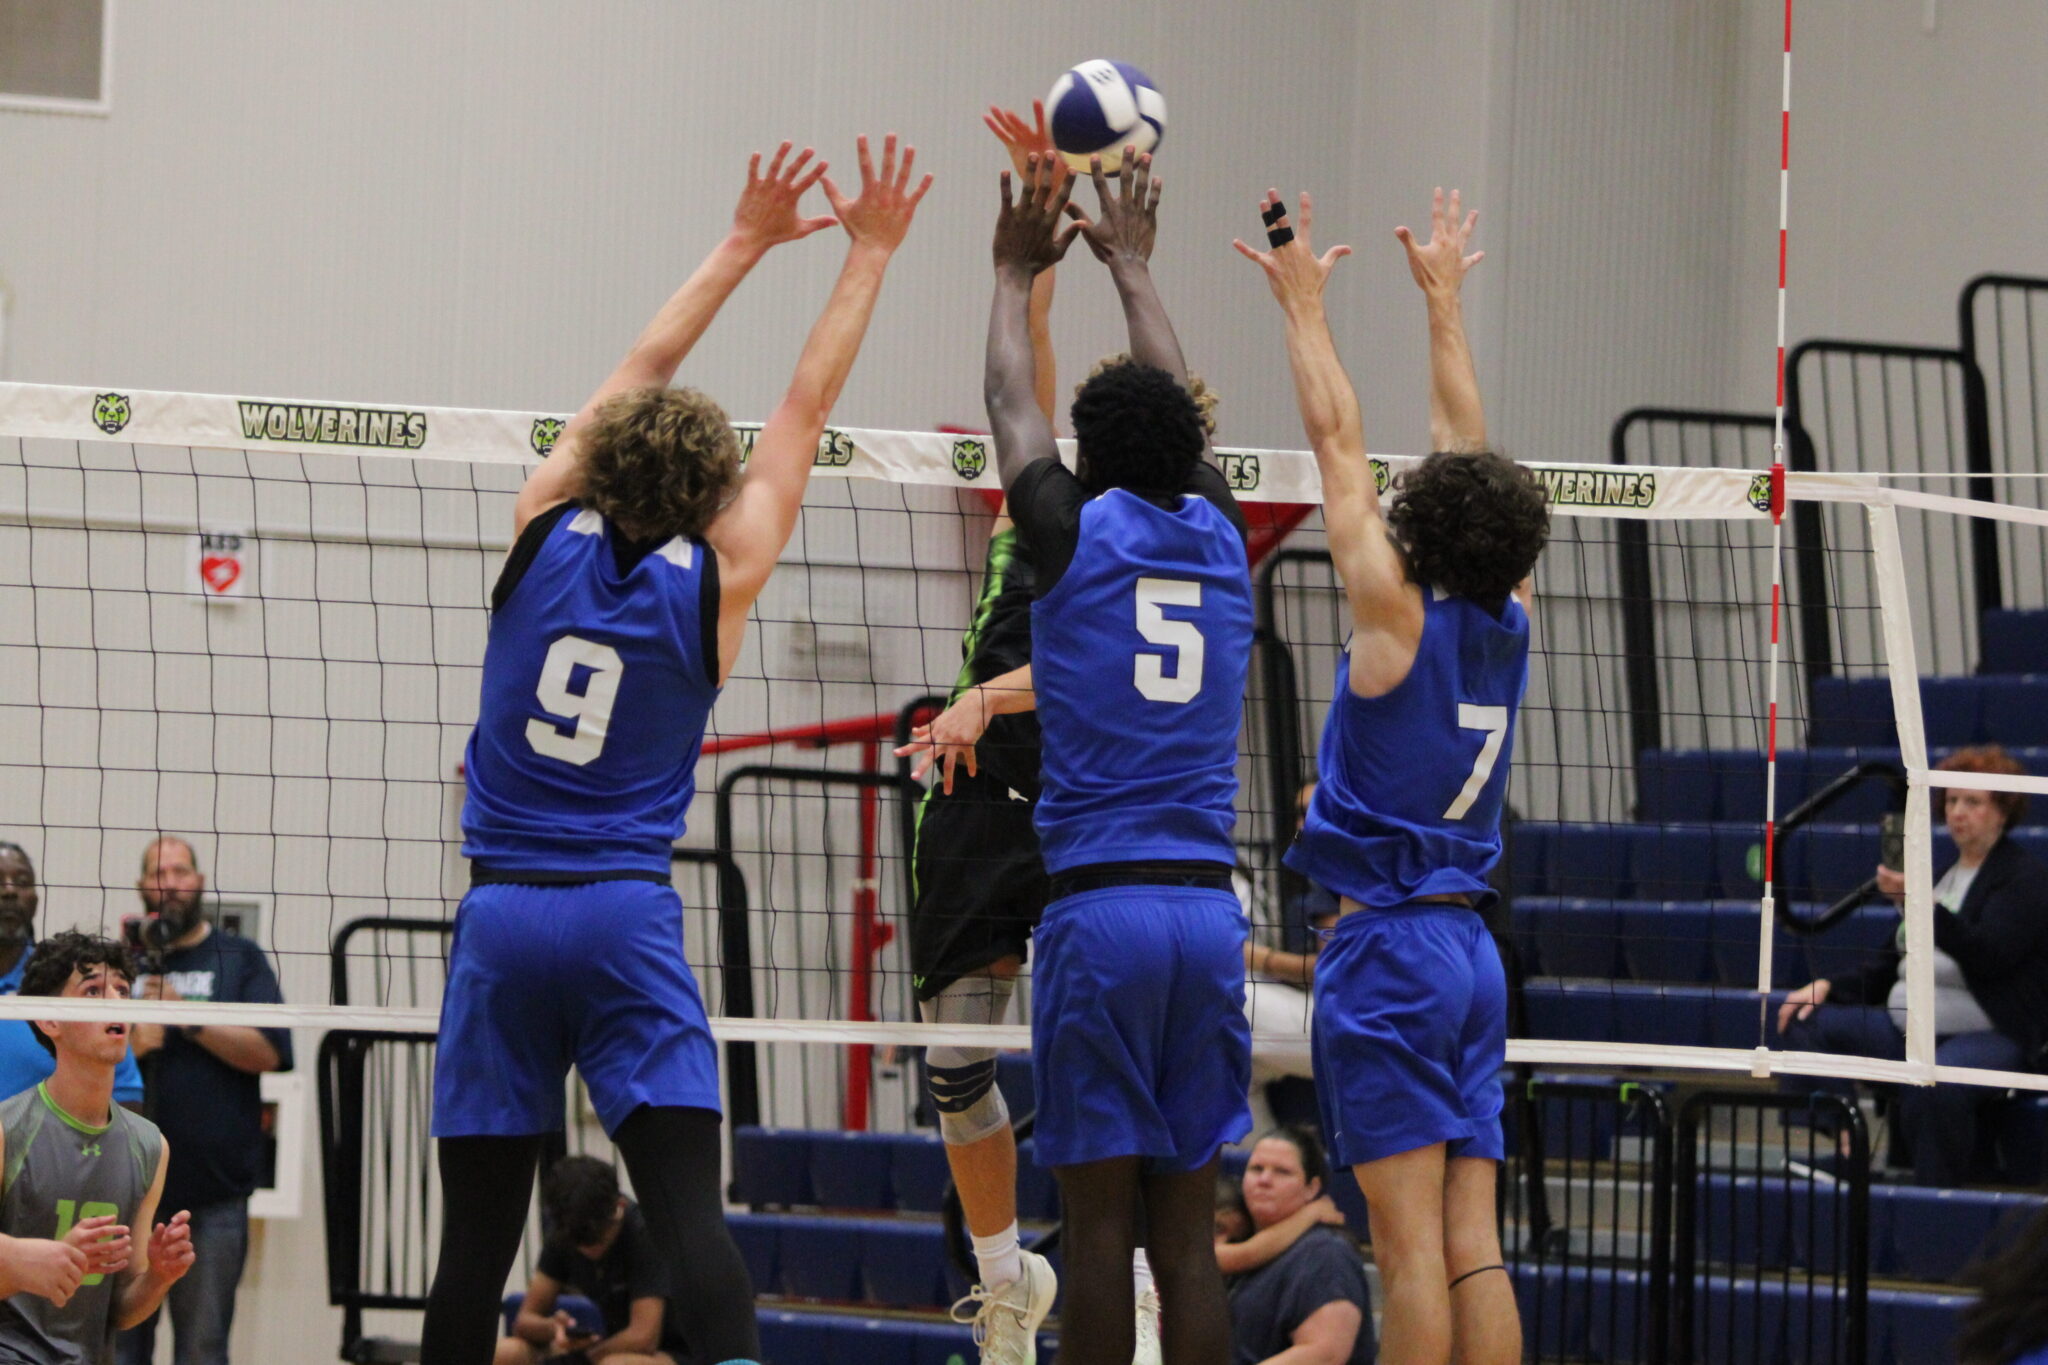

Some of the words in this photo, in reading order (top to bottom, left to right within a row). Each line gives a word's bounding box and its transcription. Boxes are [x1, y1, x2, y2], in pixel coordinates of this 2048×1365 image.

[239, 401, 427, 449] WOLVERINES
[1532, 468, 1656, 508] VERINES
[1134, 577, 1204, 703] 5
[525, 635, 624, 766] 9
[1442, 703, 1507, 820] 7
